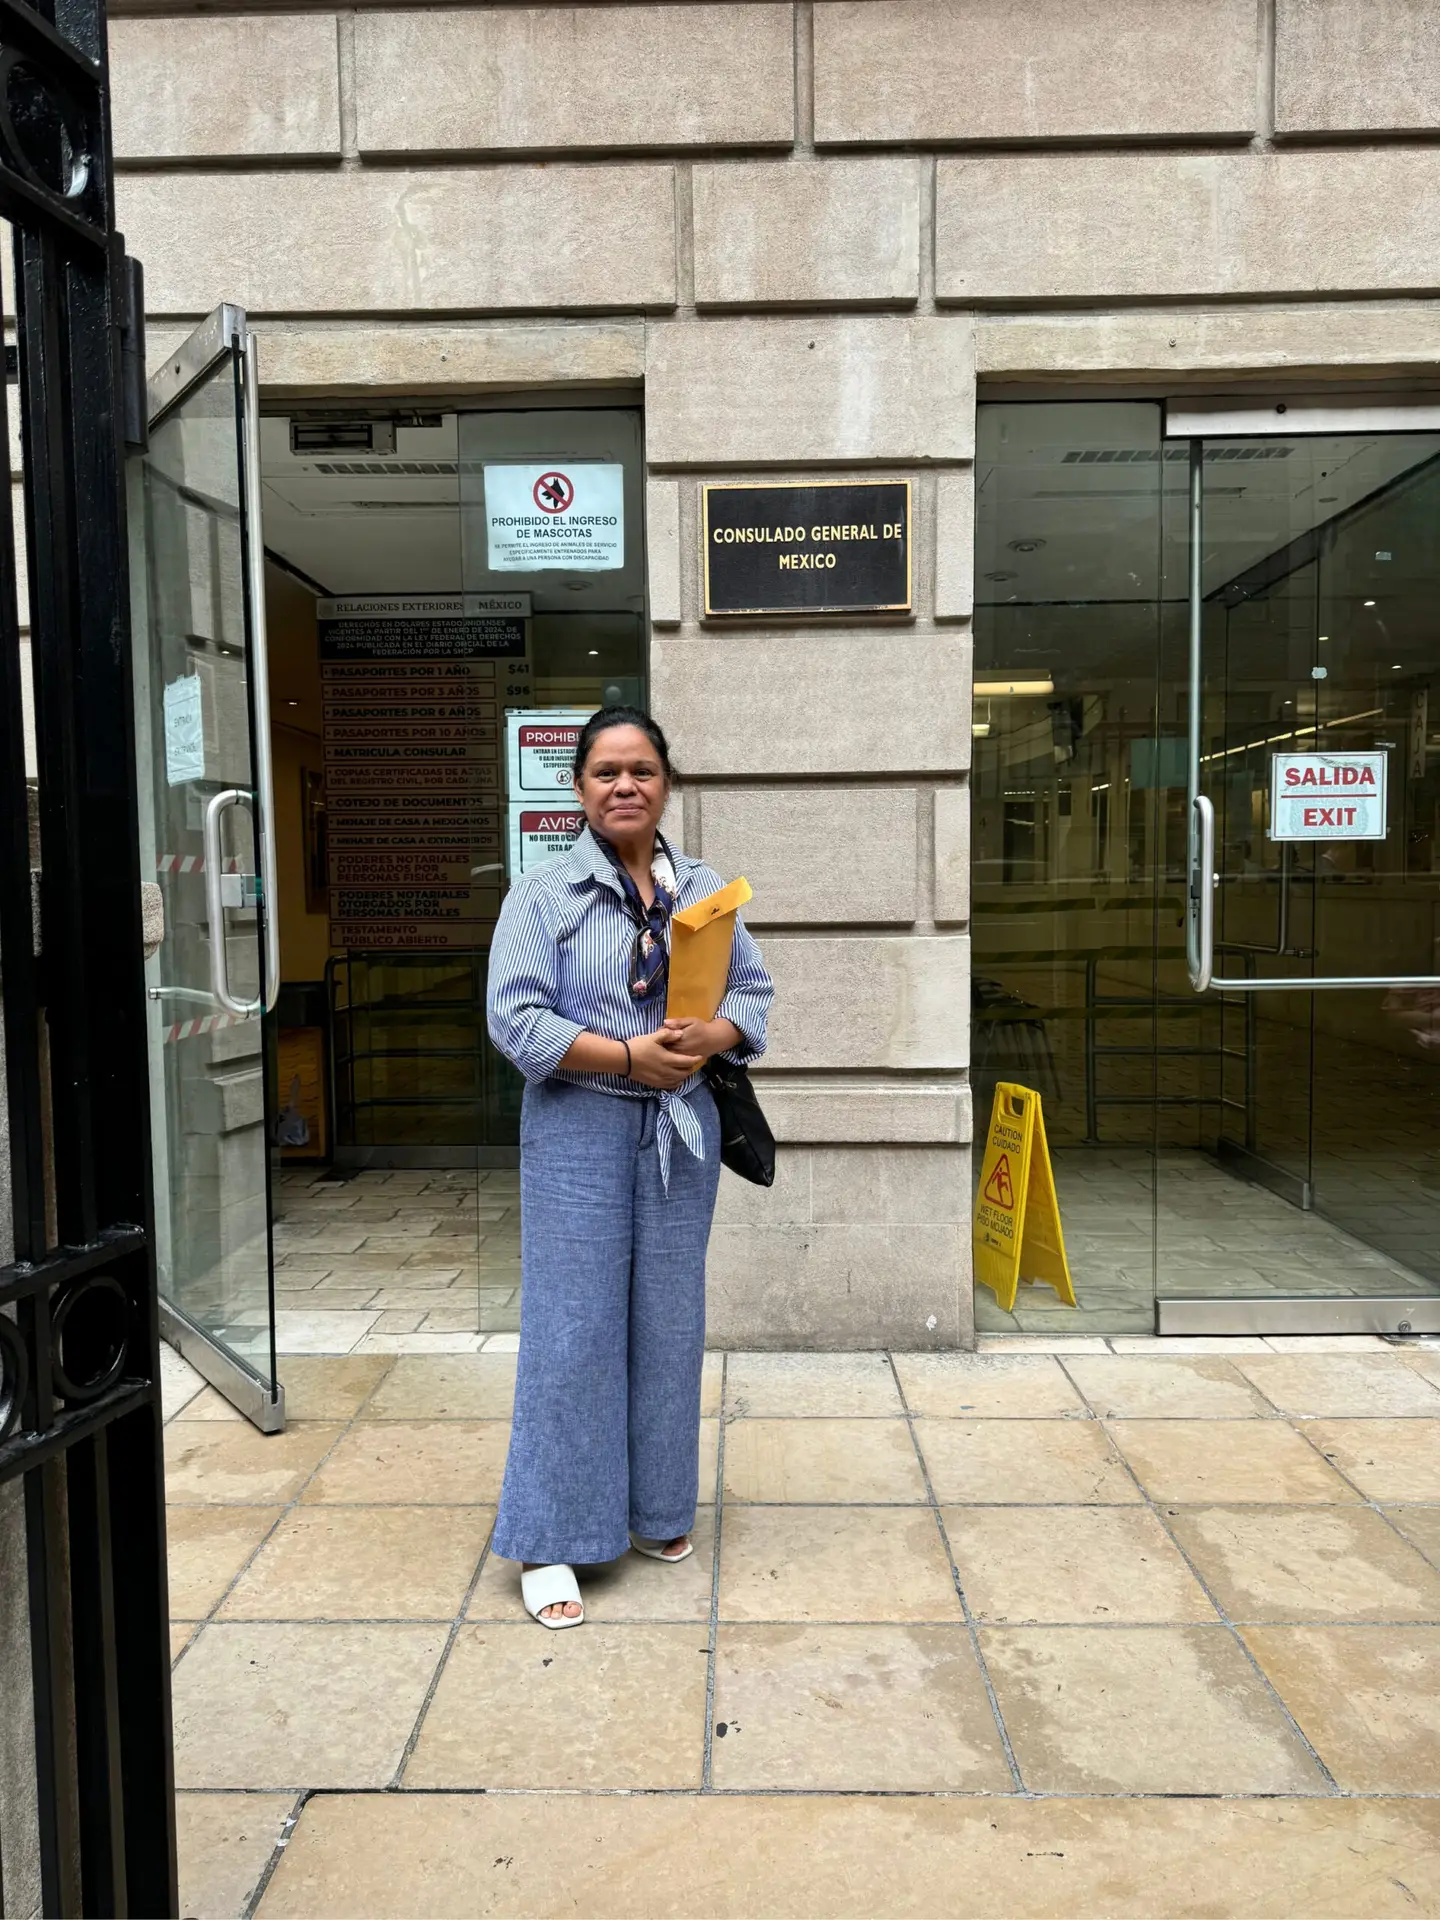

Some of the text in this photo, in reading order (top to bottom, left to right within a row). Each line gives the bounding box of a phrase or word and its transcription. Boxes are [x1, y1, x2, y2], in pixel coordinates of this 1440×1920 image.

[492, 516, 618, 526] PROHIBIDO EL INGRESO
[516, 528, 592, 538] DE MASCOTAS
[713, 524, 902, 544] CONSULADO GENERAL DE
[779, 554, 836, 570] MEXICO
[337, 599, 522, 612] RELACIONES EXTERIORES MÉXICO
[331, 665, 470, 676] PASAPORTES POR 1 AÑO
[508, 663, 529, 675] $41
[332, 685, 480, 697] PASAPORTES POR 3 AÑOS
[507, 684, 530, 696] $96
[332, 706, 481, 717] PASAPORTES POR 6 AÑOS
[333, 729, 409, 737] PASAPORTES
[412, 728, 436, 736] POR
[438, 728, 450, 736] 10
[526, 732, 579, 742] PROHIBI
[404, 747, 467, 756] CONSULAR
[1285, 767, 1375, 786] SALIDA
[336, 798, 483, 807] COTEJO DE DOCUMENTOS
[1304, 808, 1357, 826] EXIT
[338, 855, 470, 863] PODERES NOTARIALES
[337, 865, 411, 873] OTORGADOS
[337, 874, 400, 882] PERSONAS
[397, 890, 470, 898] NOTARIALES
[338, 909, 400, 917] PERSONAS
[342, 926, 417, 934] TESTAMENTO
[994, 1124, 1022, 1141] CAUTION
[993, 1136, 1020, 1154] CUIDADO
[981, 1204, 1013, 1226] WET FLOOR
[977, 1213, 1013, 1239] PISO MOJADO
